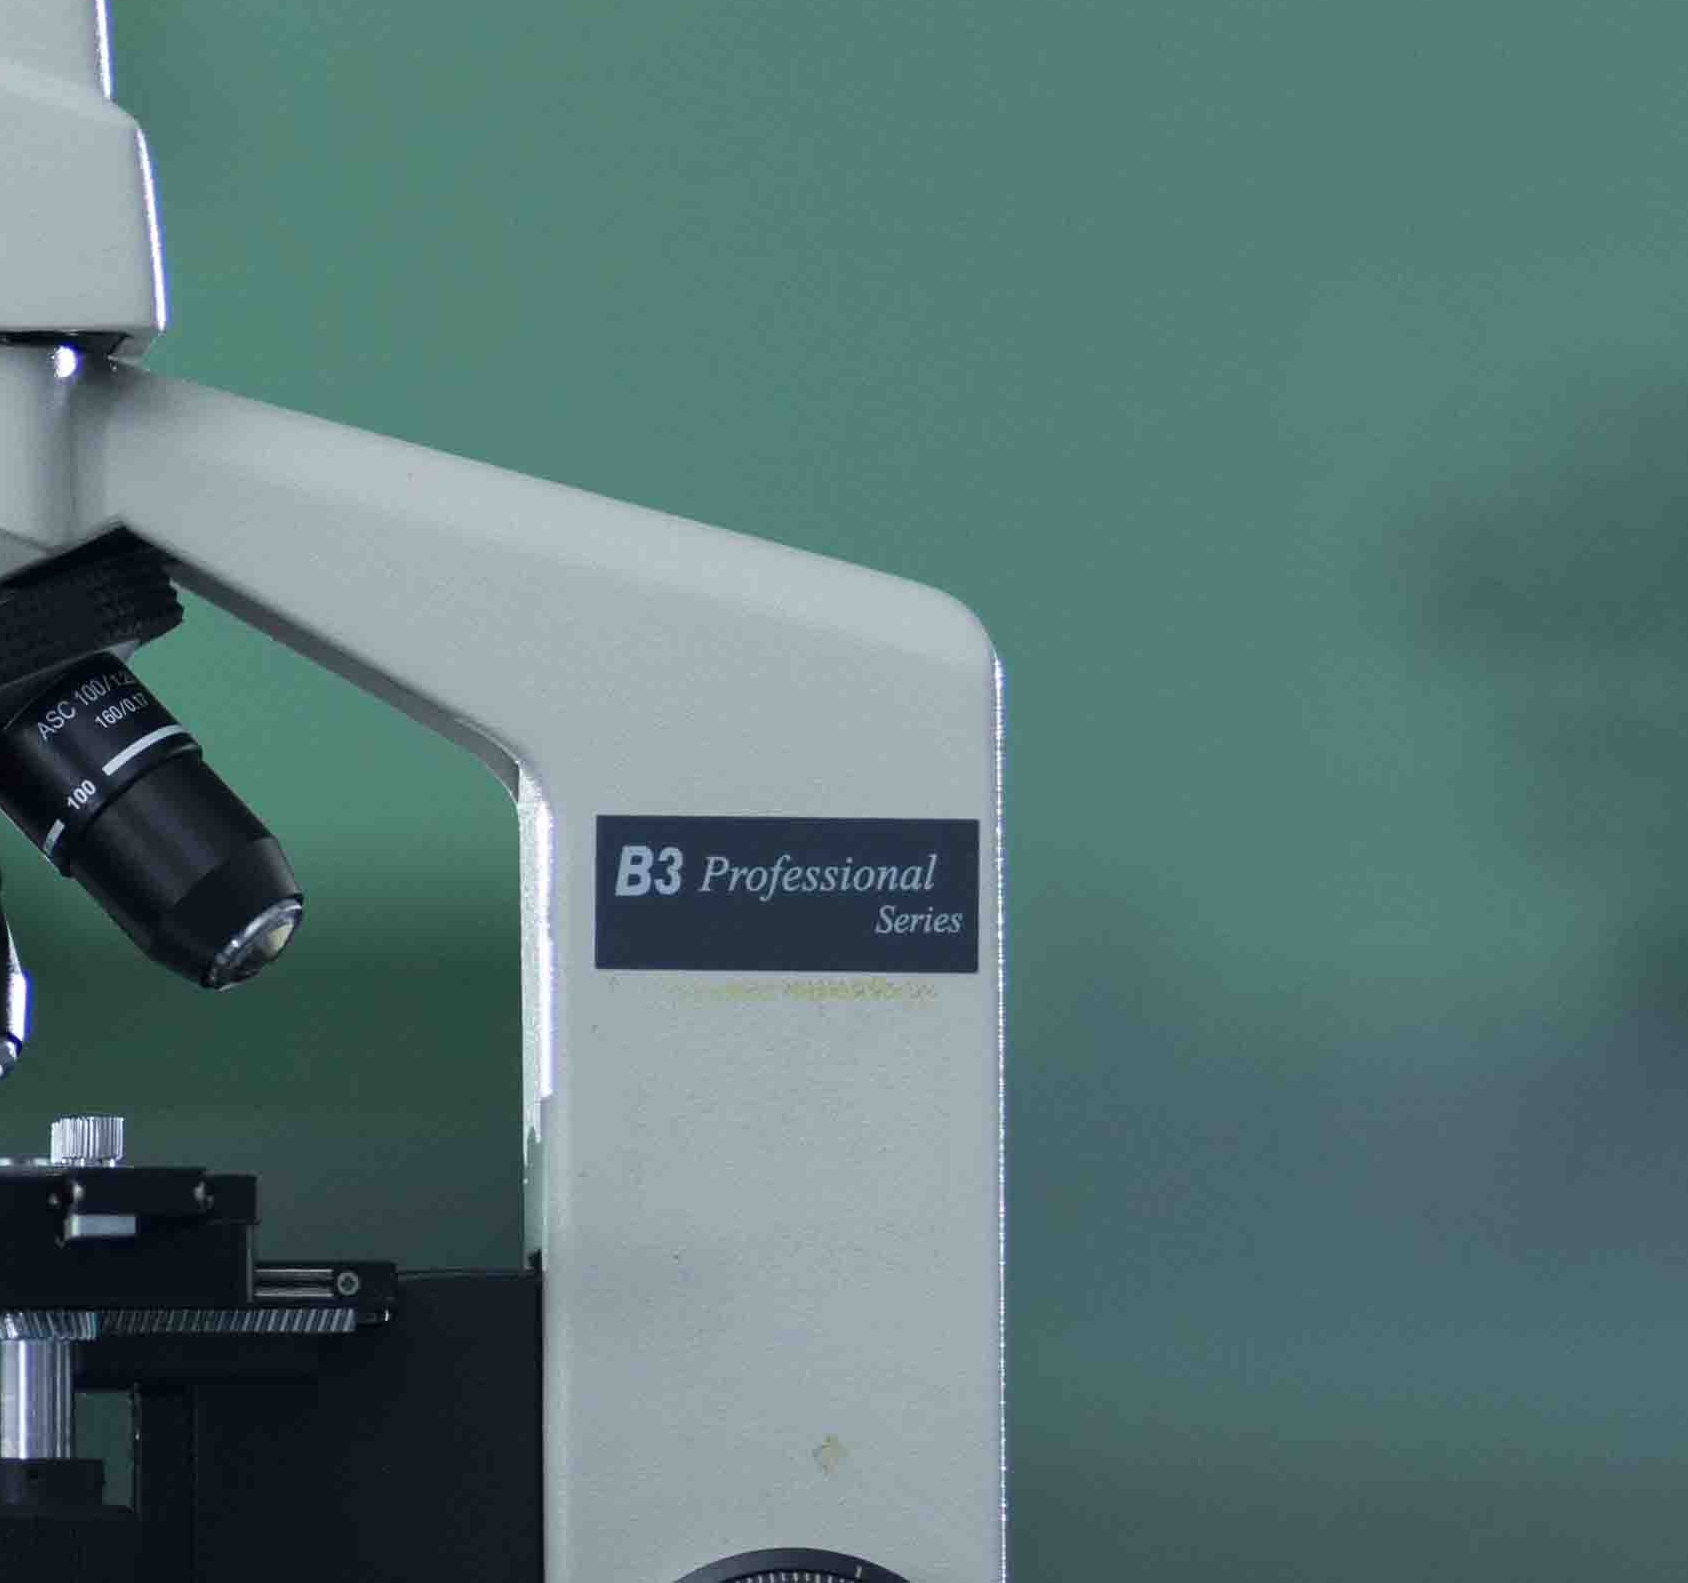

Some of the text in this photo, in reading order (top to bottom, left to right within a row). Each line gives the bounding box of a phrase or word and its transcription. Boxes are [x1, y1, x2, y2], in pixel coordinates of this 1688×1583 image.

[37, 700, 77, 742] ASC
[67, 779, 97, 810] 100
[614, 845, 939, 902] B3 Professional
[874, 904, 964, 934] Series
